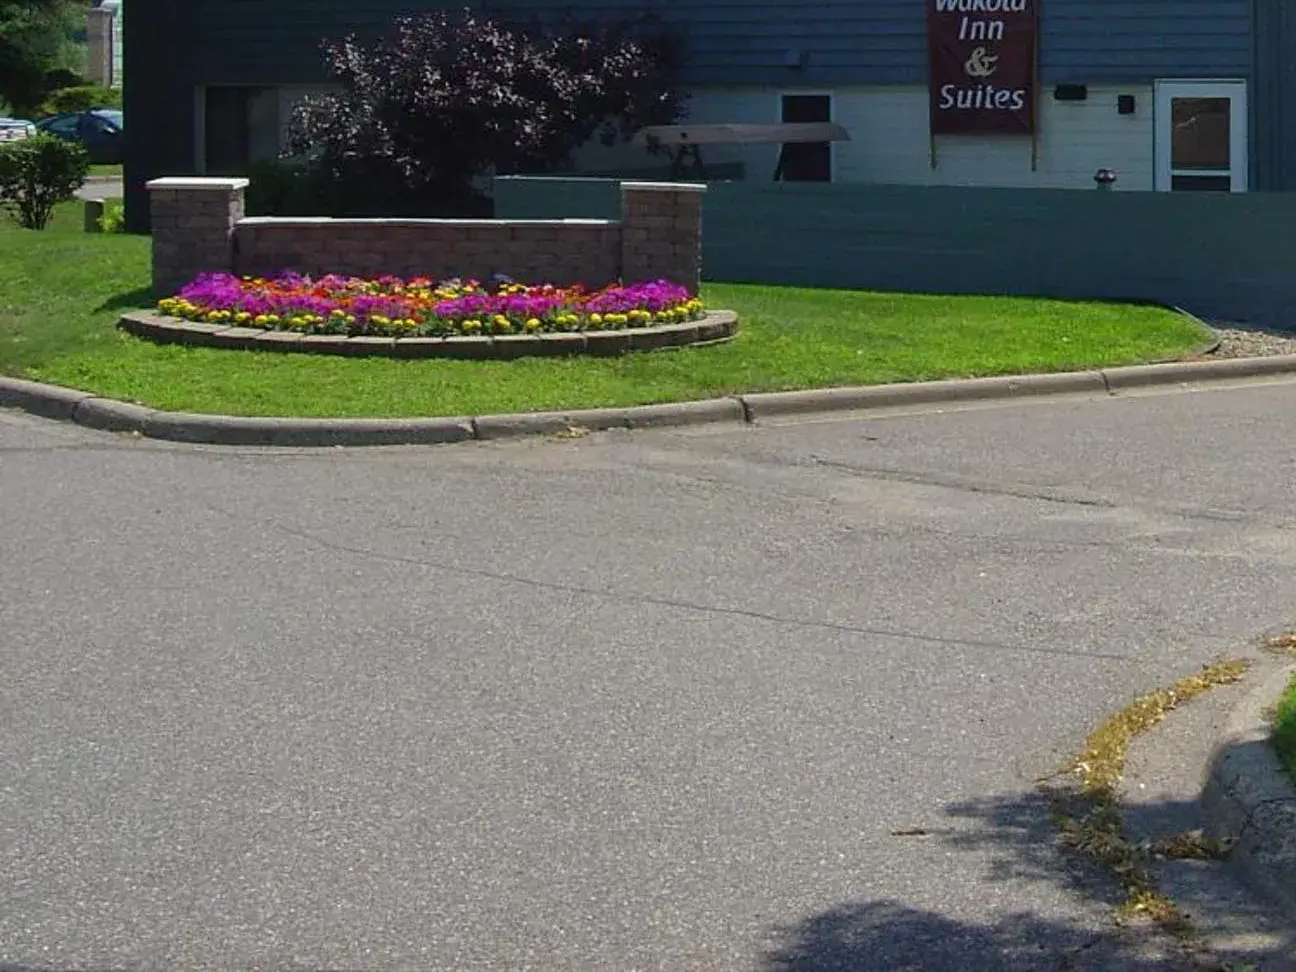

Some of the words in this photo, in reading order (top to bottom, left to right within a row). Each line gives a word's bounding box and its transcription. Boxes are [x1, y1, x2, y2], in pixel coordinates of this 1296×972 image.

[958, 17, 1004, 40] Inn
[965, 47, 999, 77] &
[939, 85, 1025, 109] Suites
